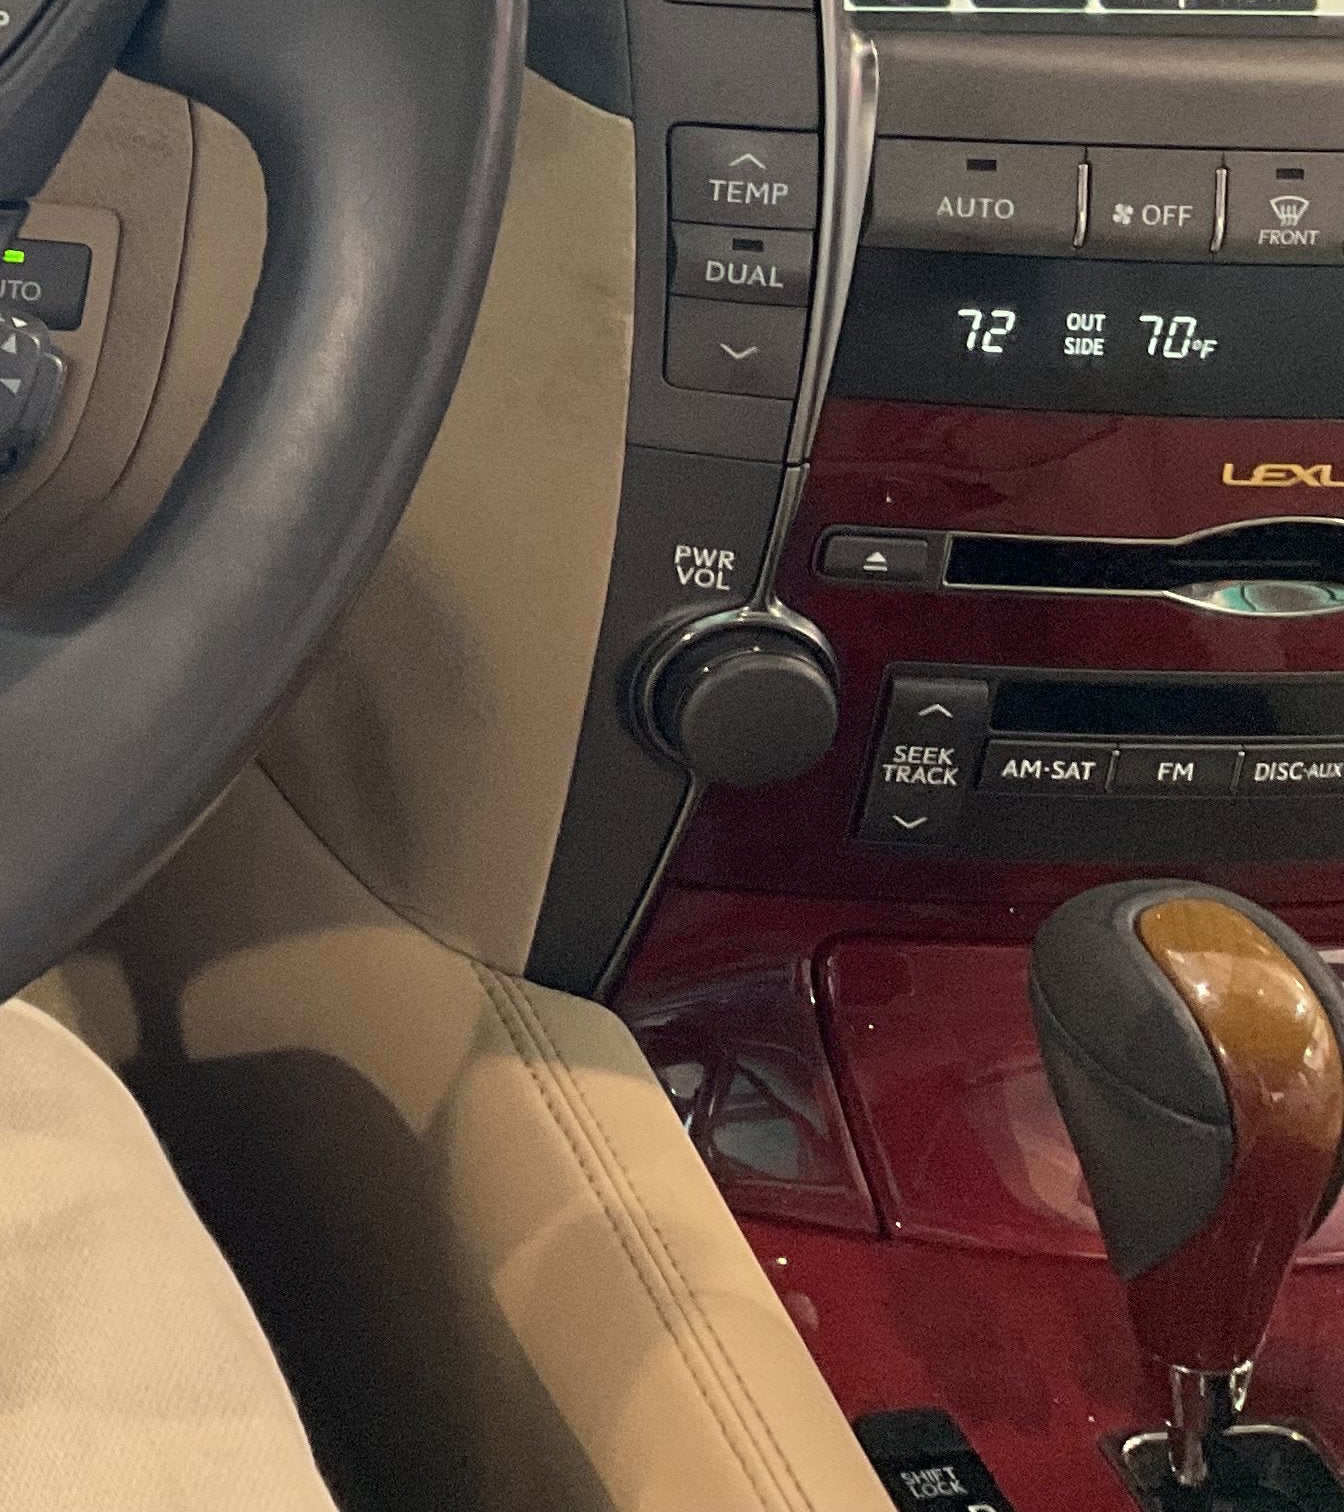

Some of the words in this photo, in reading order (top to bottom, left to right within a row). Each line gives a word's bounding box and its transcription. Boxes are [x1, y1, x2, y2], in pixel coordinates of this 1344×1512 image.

[708, 178, 789, 207] TEMP
[936, 196, 1015, 220] AUTO
[1141, 203, 1193, 227] OFF
[1258, 229, 1320, 247] FRONT
[705, 261, 784, 289] DUAL
[957, 309, 1017, 354] 72
[1065, 313, 1106, 333] OUT
[1064, 336, 1106, 356] SIDE
[674, 544, 736, 571] PWR
[675, 567, 731, 591] VOL
[893, 744, 955, 766] SEEK
[882, 763, 958, 786] TRACK
[1156, 761, 1195, 782] FM
[900, 1466, 956, 1485] SHIFT
[908, 1479, 968, 1499] LOCK
